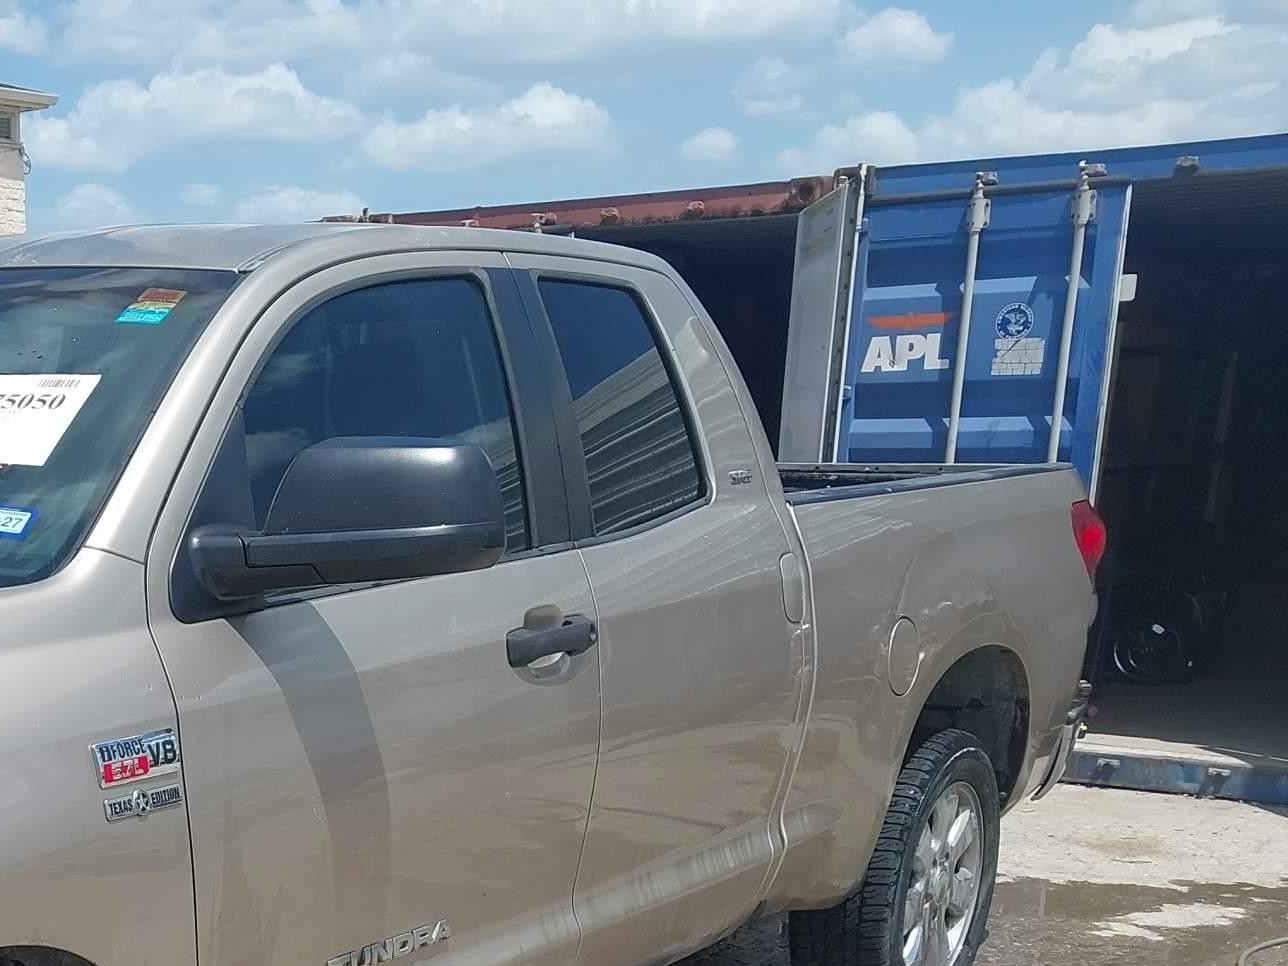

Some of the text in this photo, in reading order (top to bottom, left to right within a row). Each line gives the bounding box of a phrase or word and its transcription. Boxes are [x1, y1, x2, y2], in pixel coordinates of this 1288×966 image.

[861, 333, 951, 373] APL
[0, 516, 24, 529] 27
[147, 740, 178, 766] V8
[108, 786, 181, 817] TEXAS EDITION
